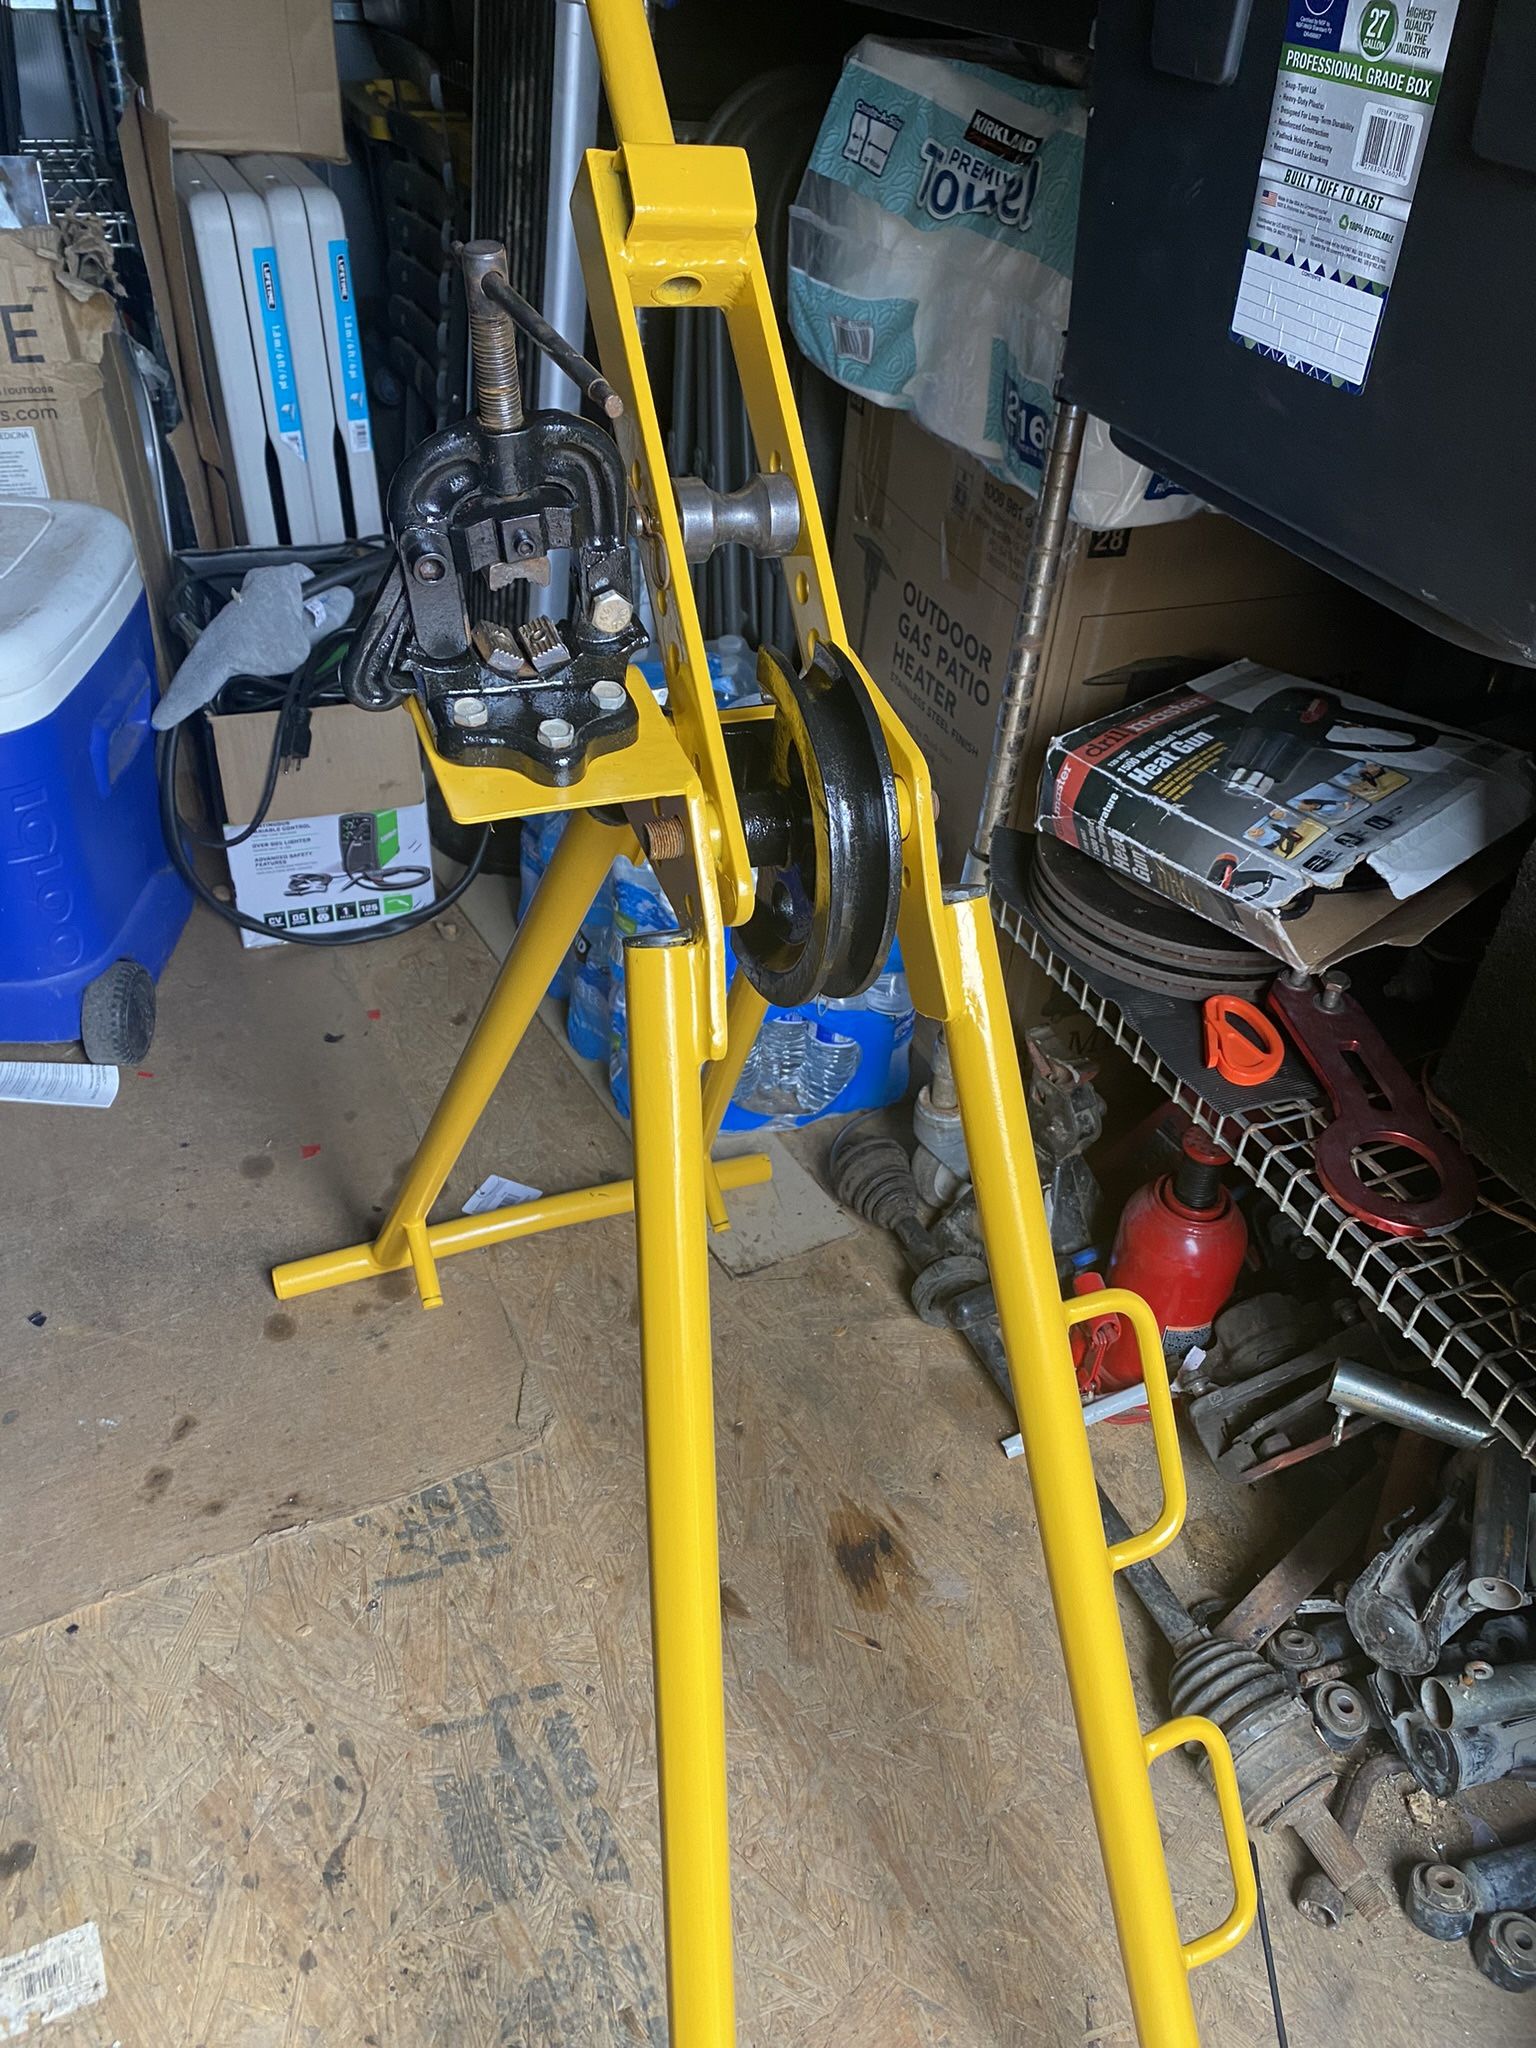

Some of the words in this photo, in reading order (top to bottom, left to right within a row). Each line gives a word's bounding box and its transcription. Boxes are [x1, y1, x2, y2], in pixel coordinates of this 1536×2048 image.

[1365, 8, 1391, 39] 27
[1404, 18, 1434, 35] QUALITY
[1406, 6, 1437, 22] HIGHEST
[1362, 38, 1386, 51] GALLON
[1396, 42, 1431, 59] INDUSTRY
[1404, 30, 1413, 41] IN
[1412, 32, 1428, 45] THE
[1285, 50, 1363, 83] PROFESSIONAL
[1365, 67, 1405, 91] GRADE
[1405, 76, 1433, 98] BOX
[971, 114, 1038, 154] KIRKLAND
[1284, 169, 1312, 189] BUILT
[1315, 178, 1338, 197] TUFF
[1341, 186, 1354, 202] TO
[1356, 190, 1384, 211] LAST
[1363, 225, 1395, 244] RECYCLABLE
[8, 386, 54, 396] OUTDOOR
[1094, 530, 1124, 551] 28
[903, 580, 992, 674] OUTDOOR
[898, 613, 932, 658] GAS
[936, 645, 990, 707] PATIO
[893, 641, 957, 719] HEATER
[890, 672, 926, 713] STAINLESS
[926, 704, 948, 734] STEEL
[951, 725, 979, 757] FINISH
[1126, 698, 1206, 732] master
[1117, 757, 1140, 773] 1500
[1136, 744, 1160, 760] Watt
[1155, 734, 1177, 747] Dual
[1127, 750, 1181, 786] Heat
[1170, 732, 1215, 754] Gun
[1132, 850, 1151, 883] Gun
[268, 916, 282, 925] CV
